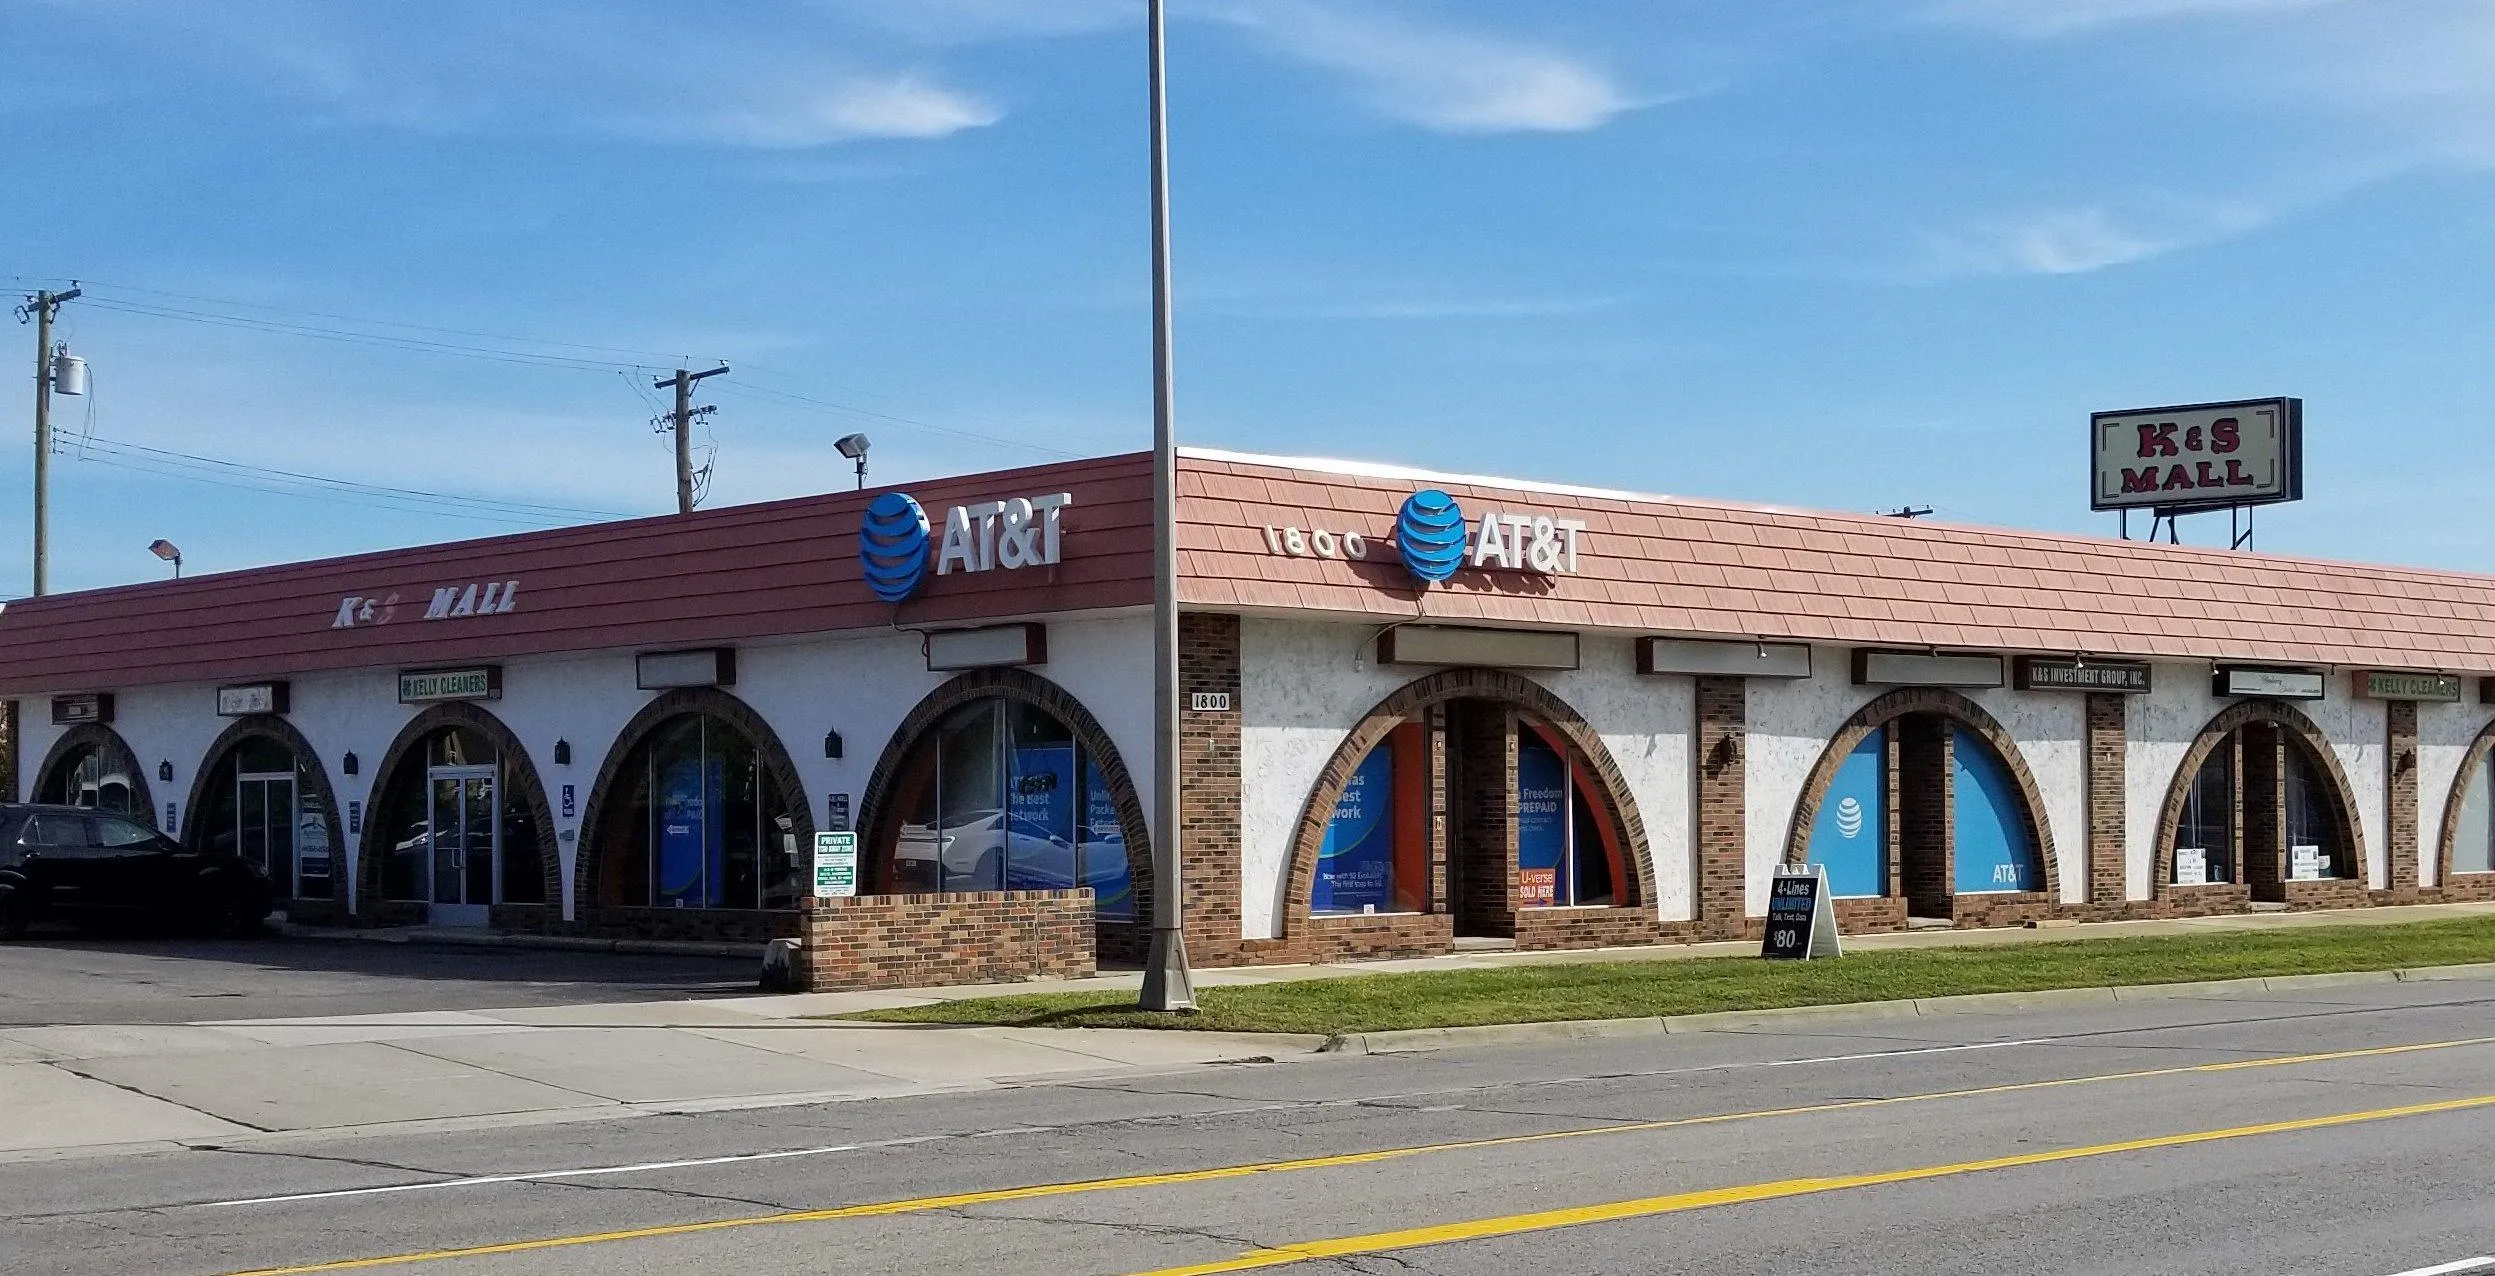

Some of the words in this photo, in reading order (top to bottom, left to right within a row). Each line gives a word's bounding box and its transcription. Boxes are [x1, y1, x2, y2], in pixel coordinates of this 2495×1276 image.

[2121, 459, 2254, 494] MALL
[937, 492, 1072, 575] AT&T
[1263, 524, 1367, 560] 1800
[1471, 512, 1586, 574] AT&T
[424, 581, 520, 620] MALL
[413, 678, 438, 696] KELLY
[440, 675, 486, 694] CLEANERS
[2051, 667, 2099, 684] INVESTMENT
[2101, 669, 2128, 686] GROUP,
[2130, 671, 2145, 685] INC.
[2377, 678, 2407, 695] KELLY
[1195, 694, 1226, 708] 1800
[1523, 787, 1562, 799] Freedom
[821, 836, 851, 845] PRIVATE
[1521, 871, 1553, 883] U-verse
[1992, 863, 2024, 883] AT&T
[1520, 885, 1536, 898] SOLD
[1538, 885, 1554, 898] HERE
[1774, 930, 1796, 948] $80
